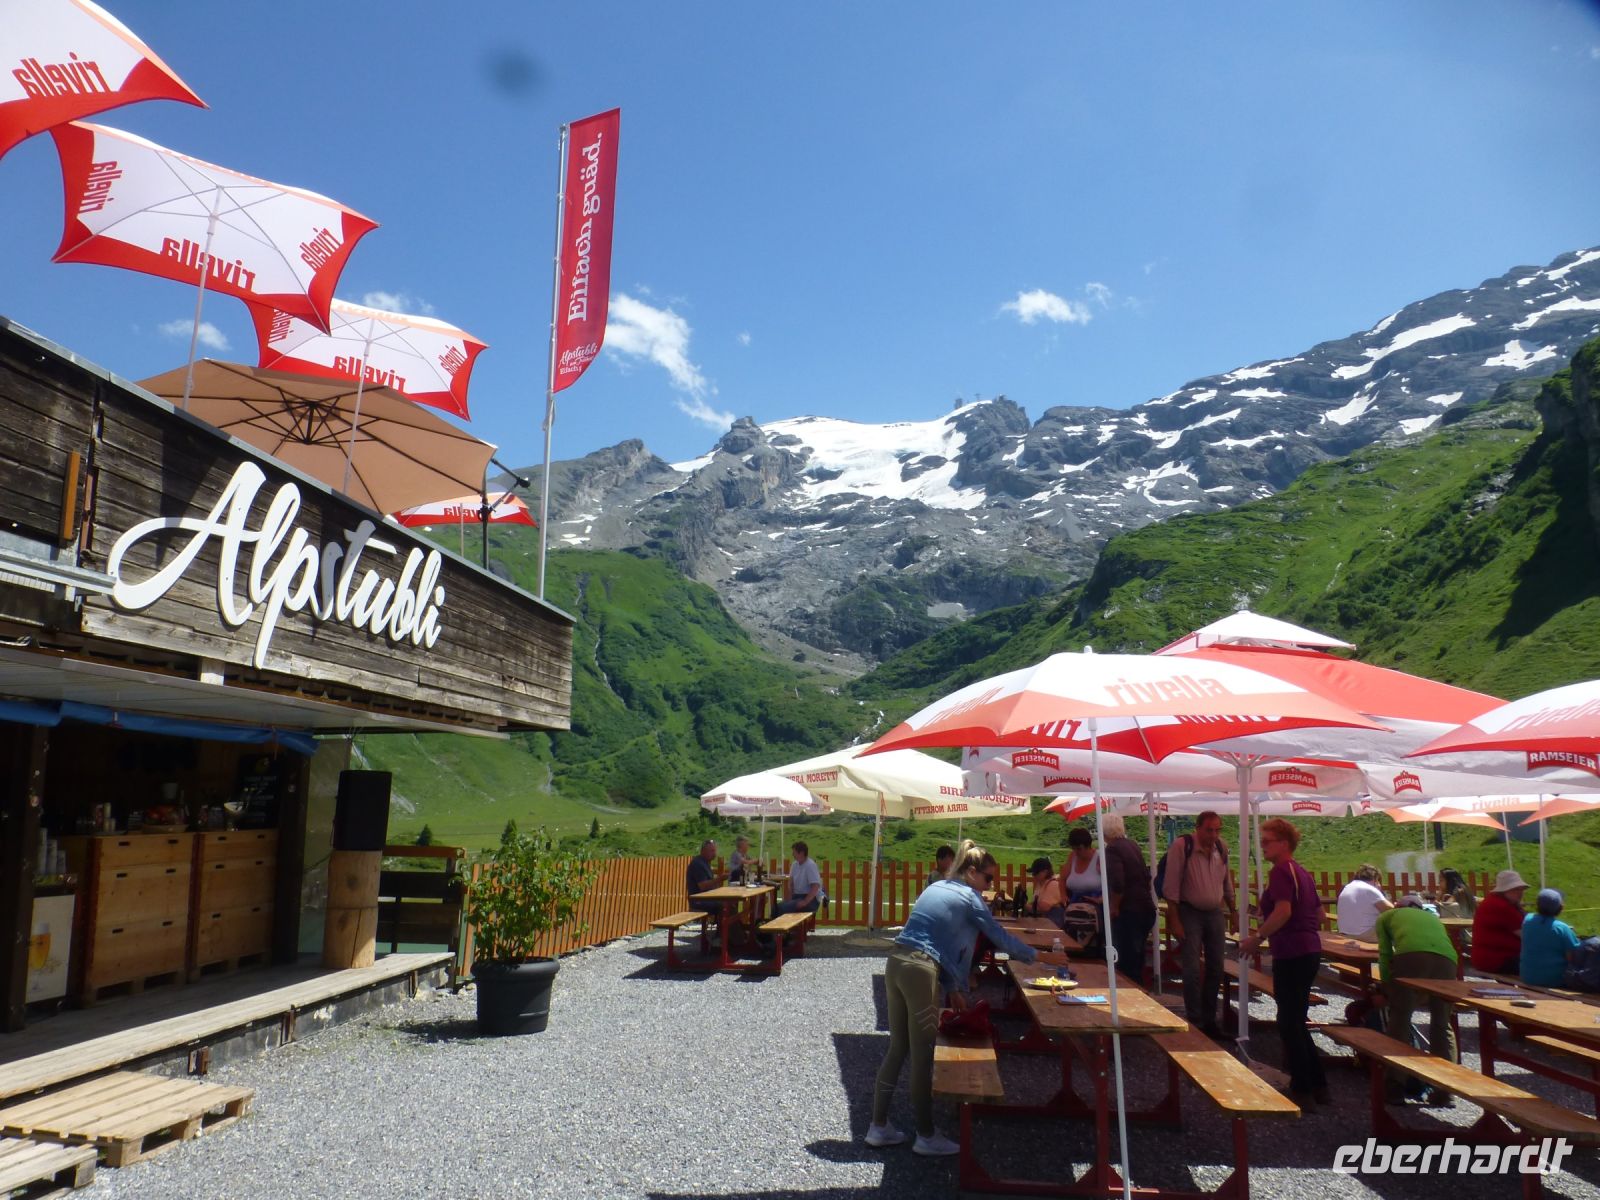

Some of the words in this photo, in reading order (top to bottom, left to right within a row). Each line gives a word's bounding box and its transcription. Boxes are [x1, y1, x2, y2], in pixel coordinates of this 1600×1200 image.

[568, 218, 592, 325] Eifach
[581, 132, 602, 217] guäd.
[1103, 674, 1234, 707] rivella
[1529, 751, 1597, 769] RAMSEIER
